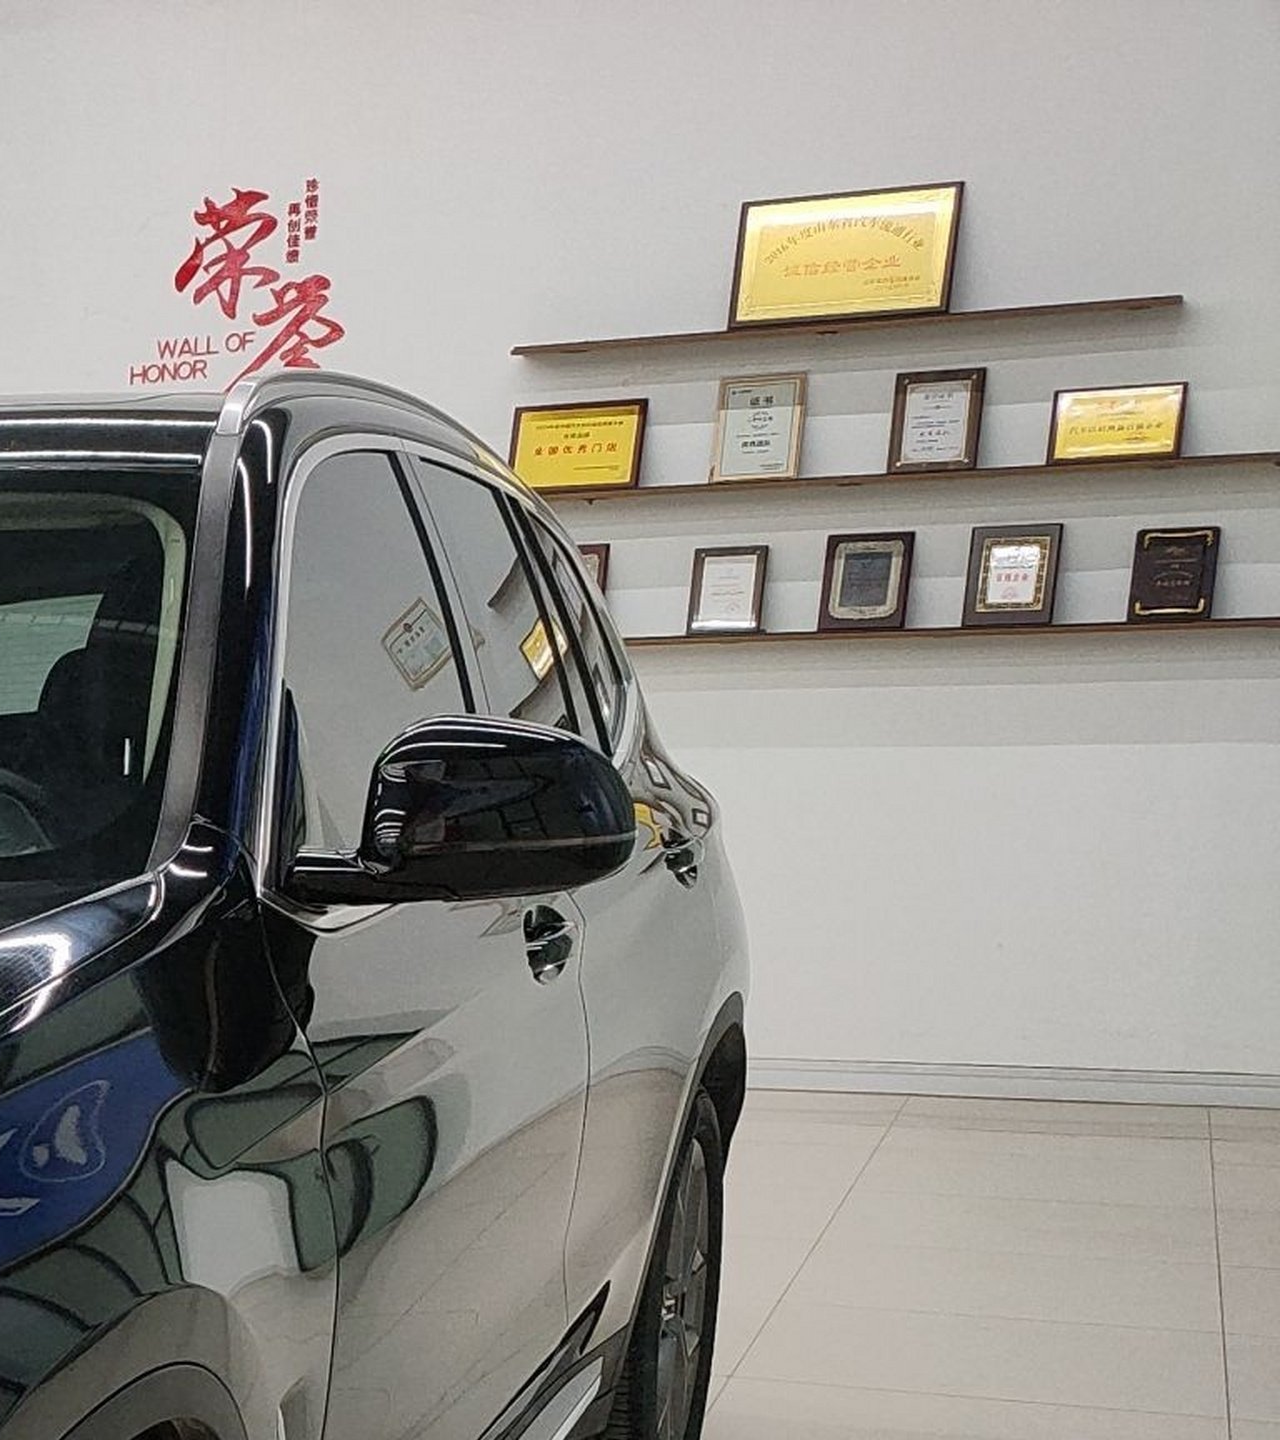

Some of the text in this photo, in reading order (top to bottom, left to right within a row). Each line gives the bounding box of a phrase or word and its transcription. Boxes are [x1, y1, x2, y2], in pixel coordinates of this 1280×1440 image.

[174, 186, 346, 394] 荣誉
[157, 331, 255, 360] WALL OF
[129, 359, 208, 386] HONOR
